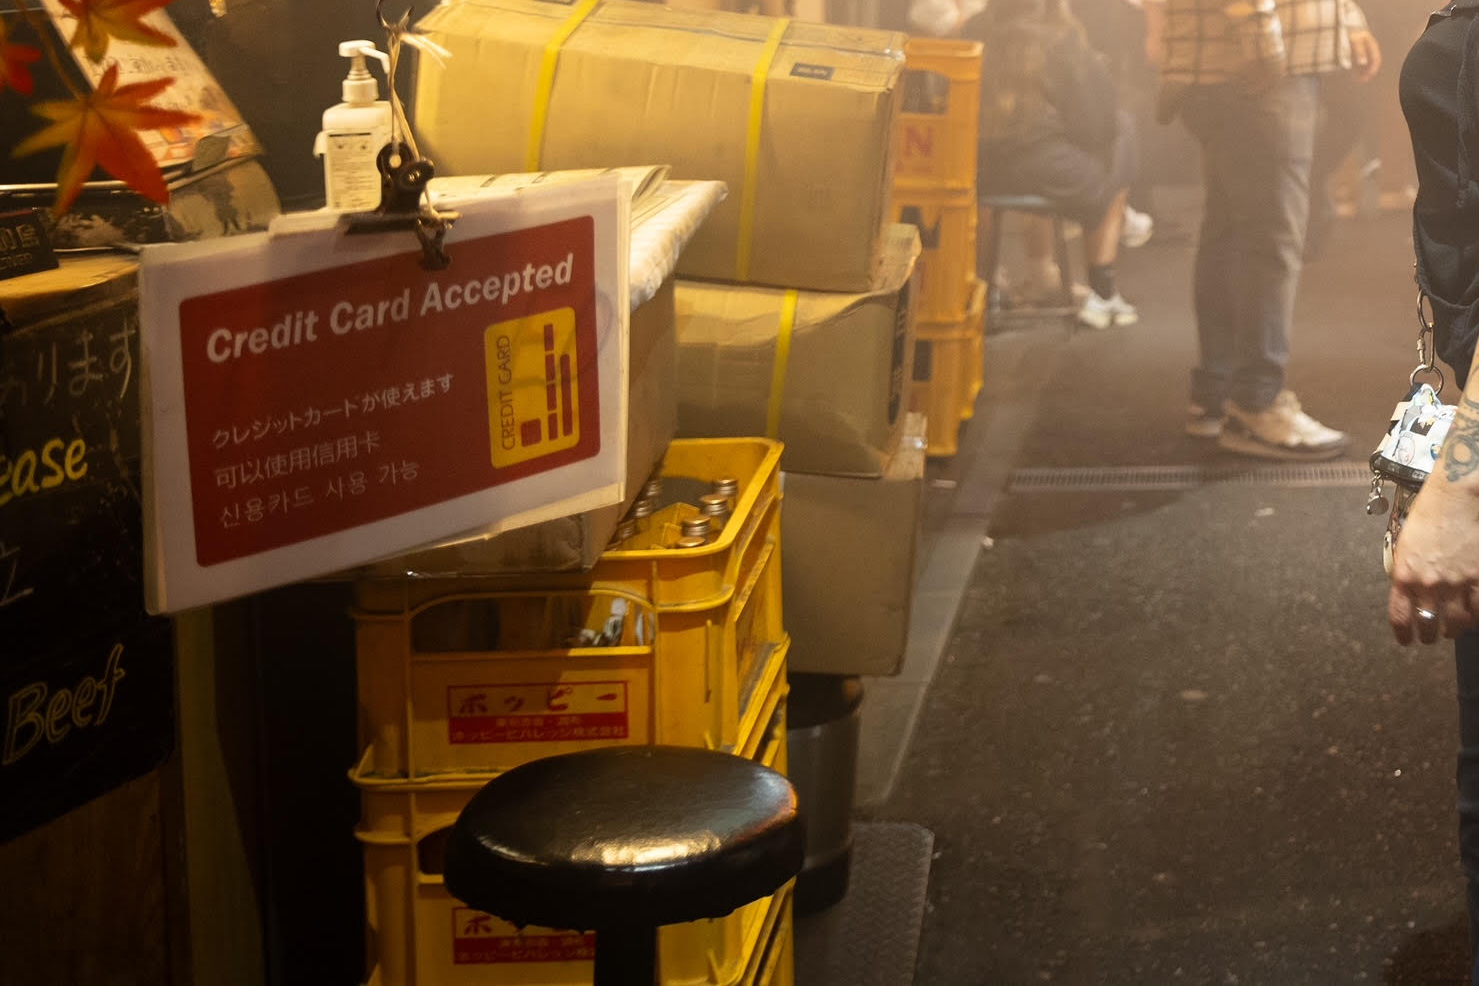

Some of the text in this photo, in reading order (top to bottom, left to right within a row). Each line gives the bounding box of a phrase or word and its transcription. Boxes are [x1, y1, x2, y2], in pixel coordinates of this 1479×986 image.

[206, 253, 575, 364] Credit Card Accepted
[211, 372, 455, 450] クレジットカードが使えます
[497, 334, 516, 451] CREDIT CARD
[215, 429, 382, 489] 可以使用信用卡
[219, 458, 421, 529] 신용카드 사용 가능
[1, 641, 128, 767] Beef
[457, 686, 620, 715] ホッピー
